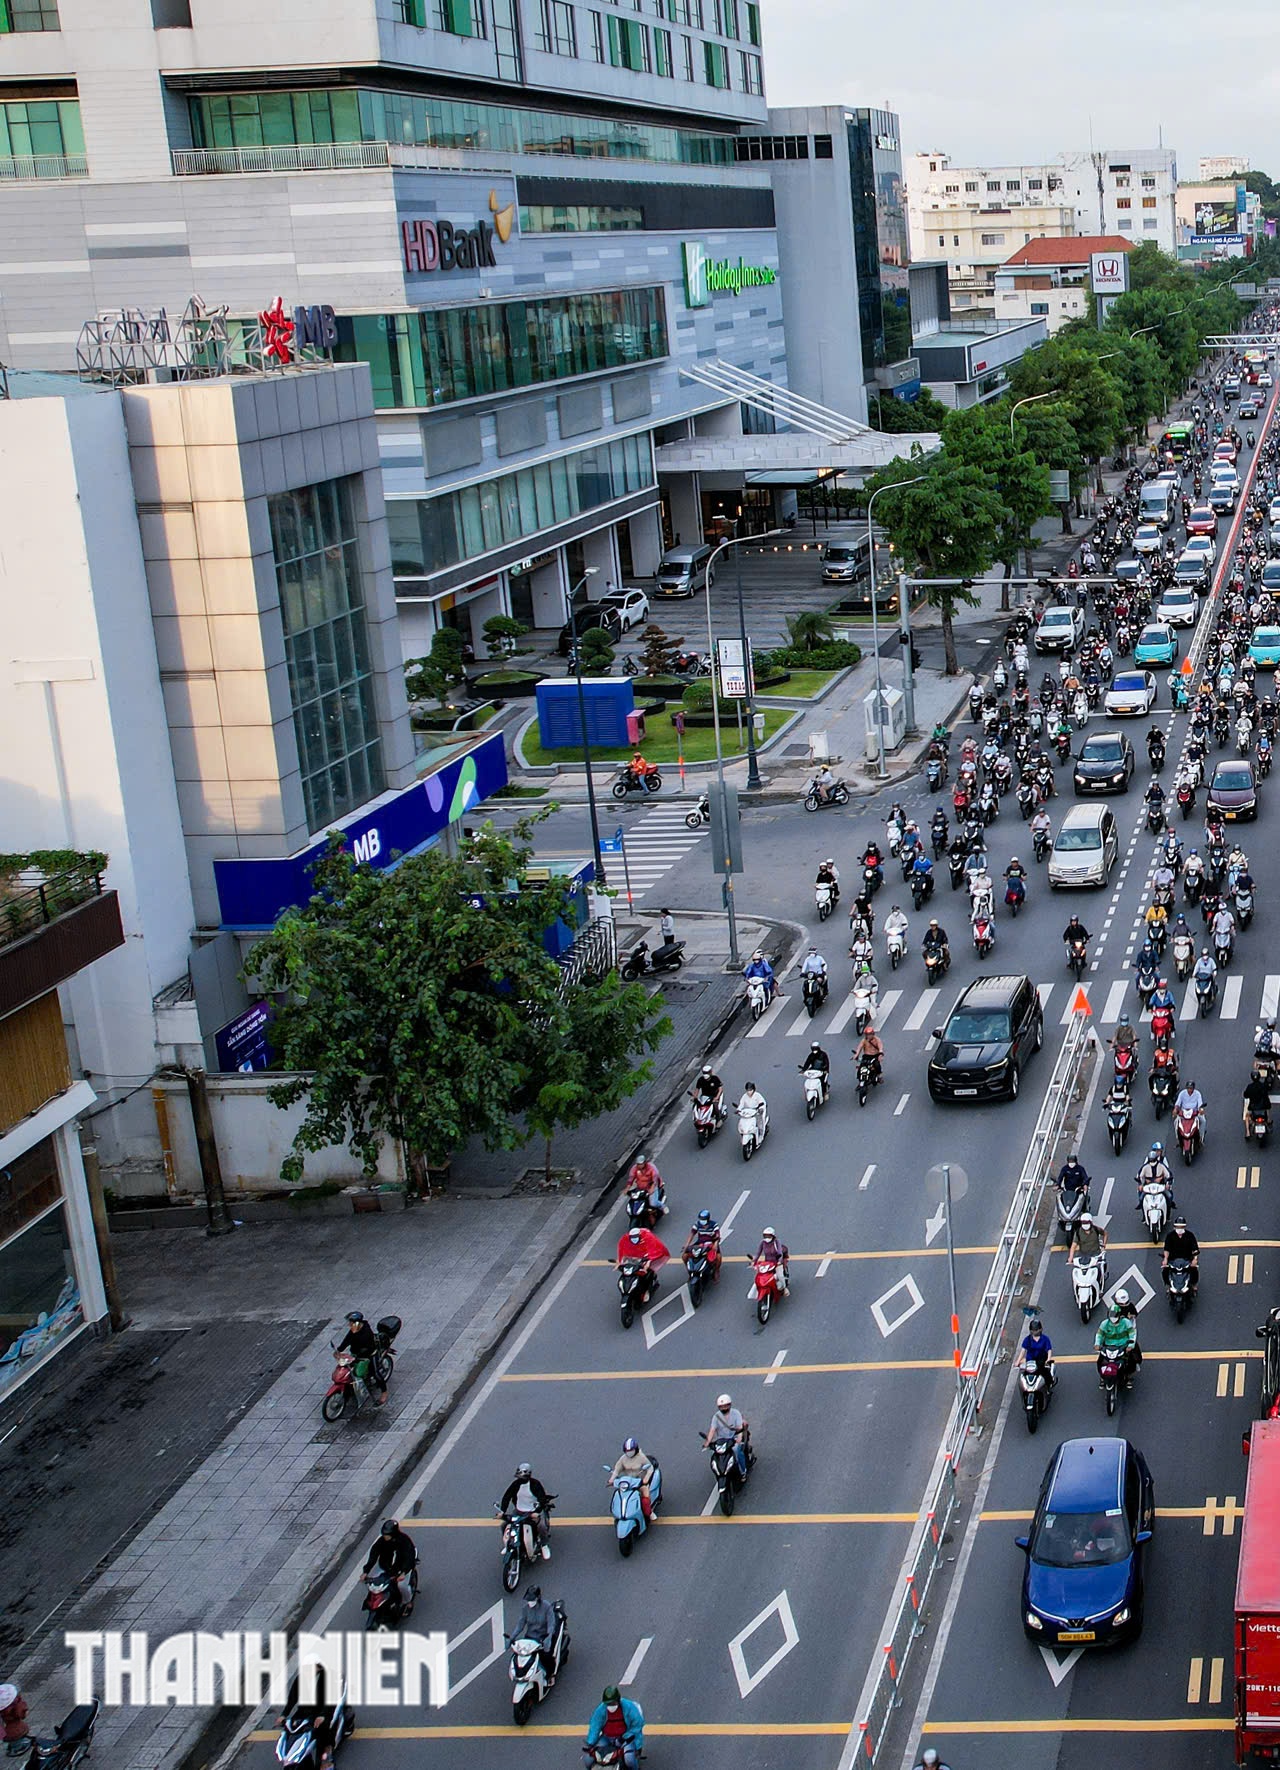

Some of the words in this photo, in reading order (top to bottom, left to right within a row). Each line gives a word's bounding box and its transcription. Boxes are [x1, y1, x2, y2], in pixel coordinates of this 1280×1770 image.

[402, 220, 497, 272] HDBank
[294, 304, 338, 349] MB
[353, 827, 381, 867] MB
